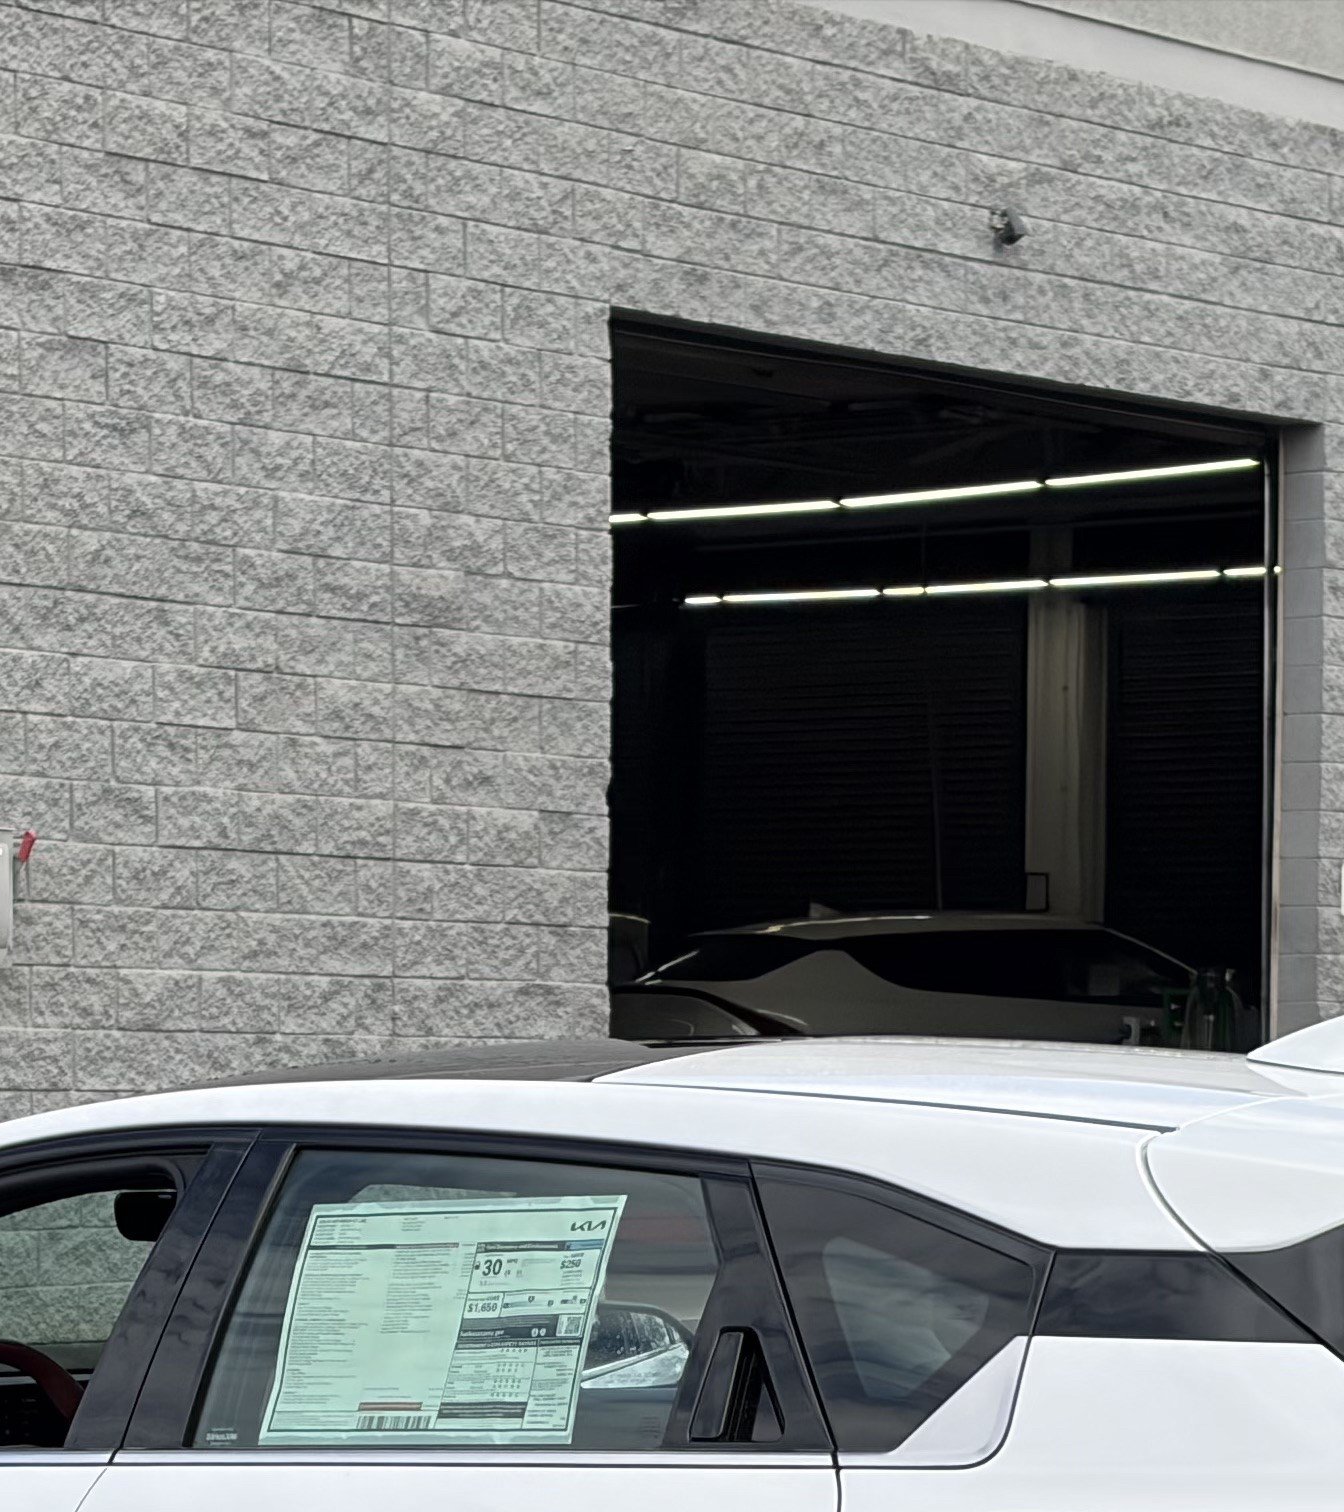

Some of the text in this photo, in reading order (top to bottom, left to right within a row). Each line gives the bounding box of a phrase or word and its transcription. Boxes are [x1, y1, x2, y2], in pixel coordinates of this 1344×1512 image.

[482, 1259, 503, 1276] 30
[559, 1258, 582, 1270] $250
[467, 1302, 498, 1314] $1,650
